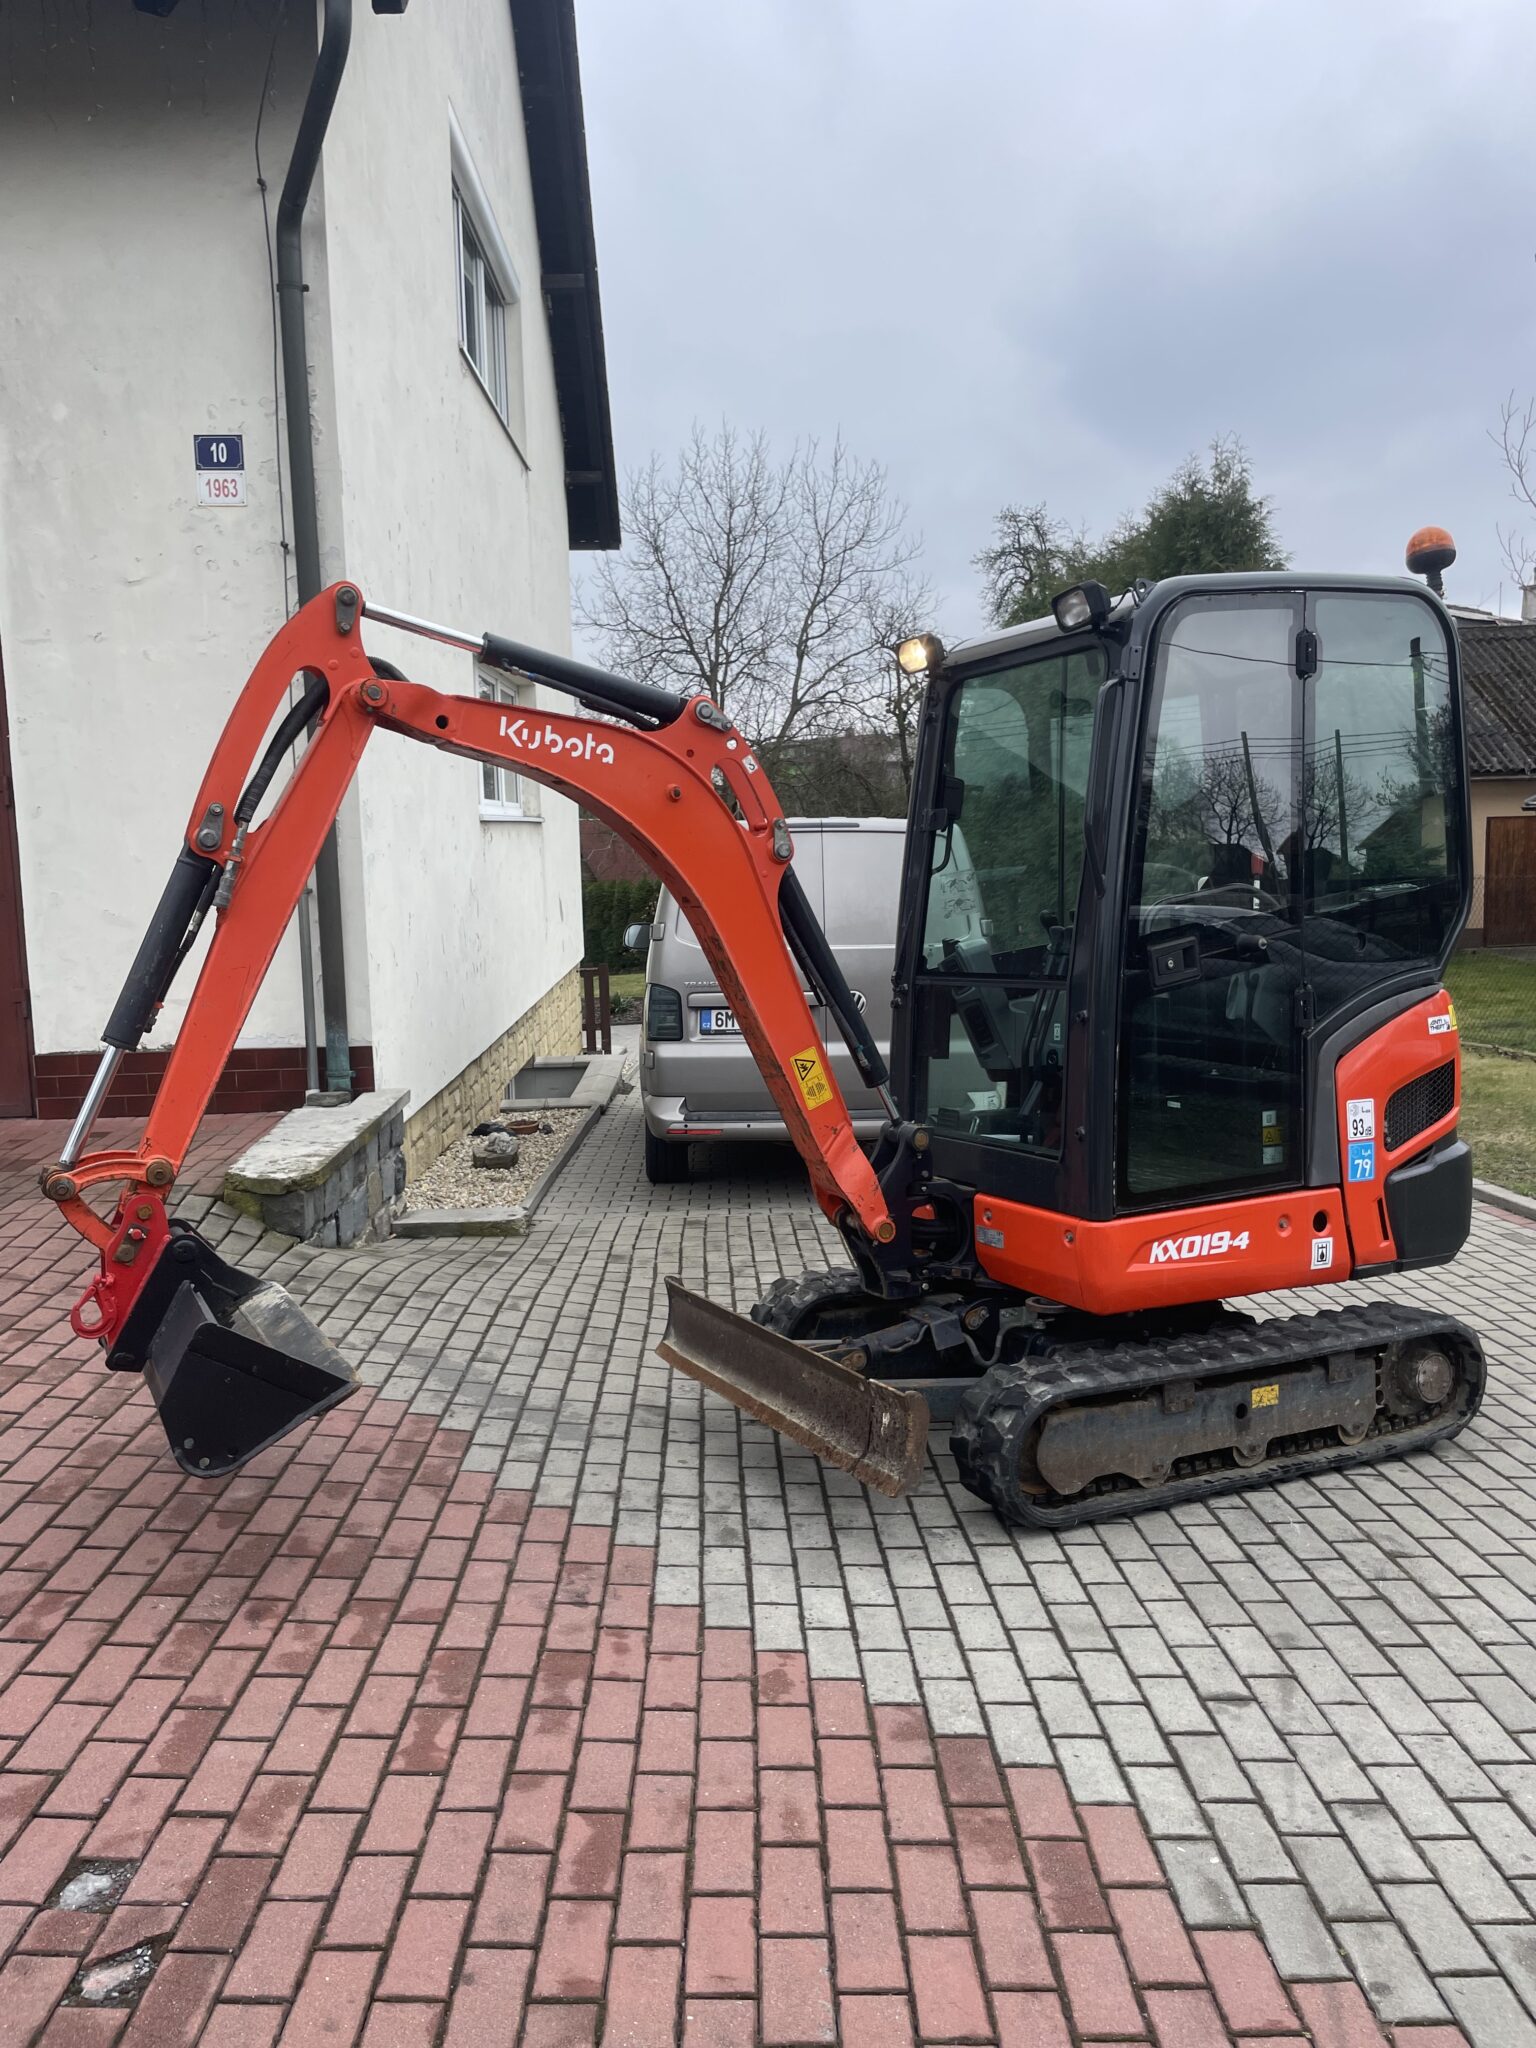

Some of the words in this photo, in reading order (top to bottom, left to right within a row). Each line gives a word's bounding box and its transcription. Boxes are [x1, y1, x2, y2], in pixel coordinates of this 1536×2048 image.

[210, 442, 228, 463] 10
[205, 478, 238, 498] 1963
[499, 715, 615, 765] Kubota
[715, 1011, 735, 1028] 6M
[1352, 1118, 1365, 1136] 93
[1365, 1126, 1372, 1136] dB
[1354, 1159, 1372, 1178] 79
[1149, 1230, 1250, 1264] KX019-4
